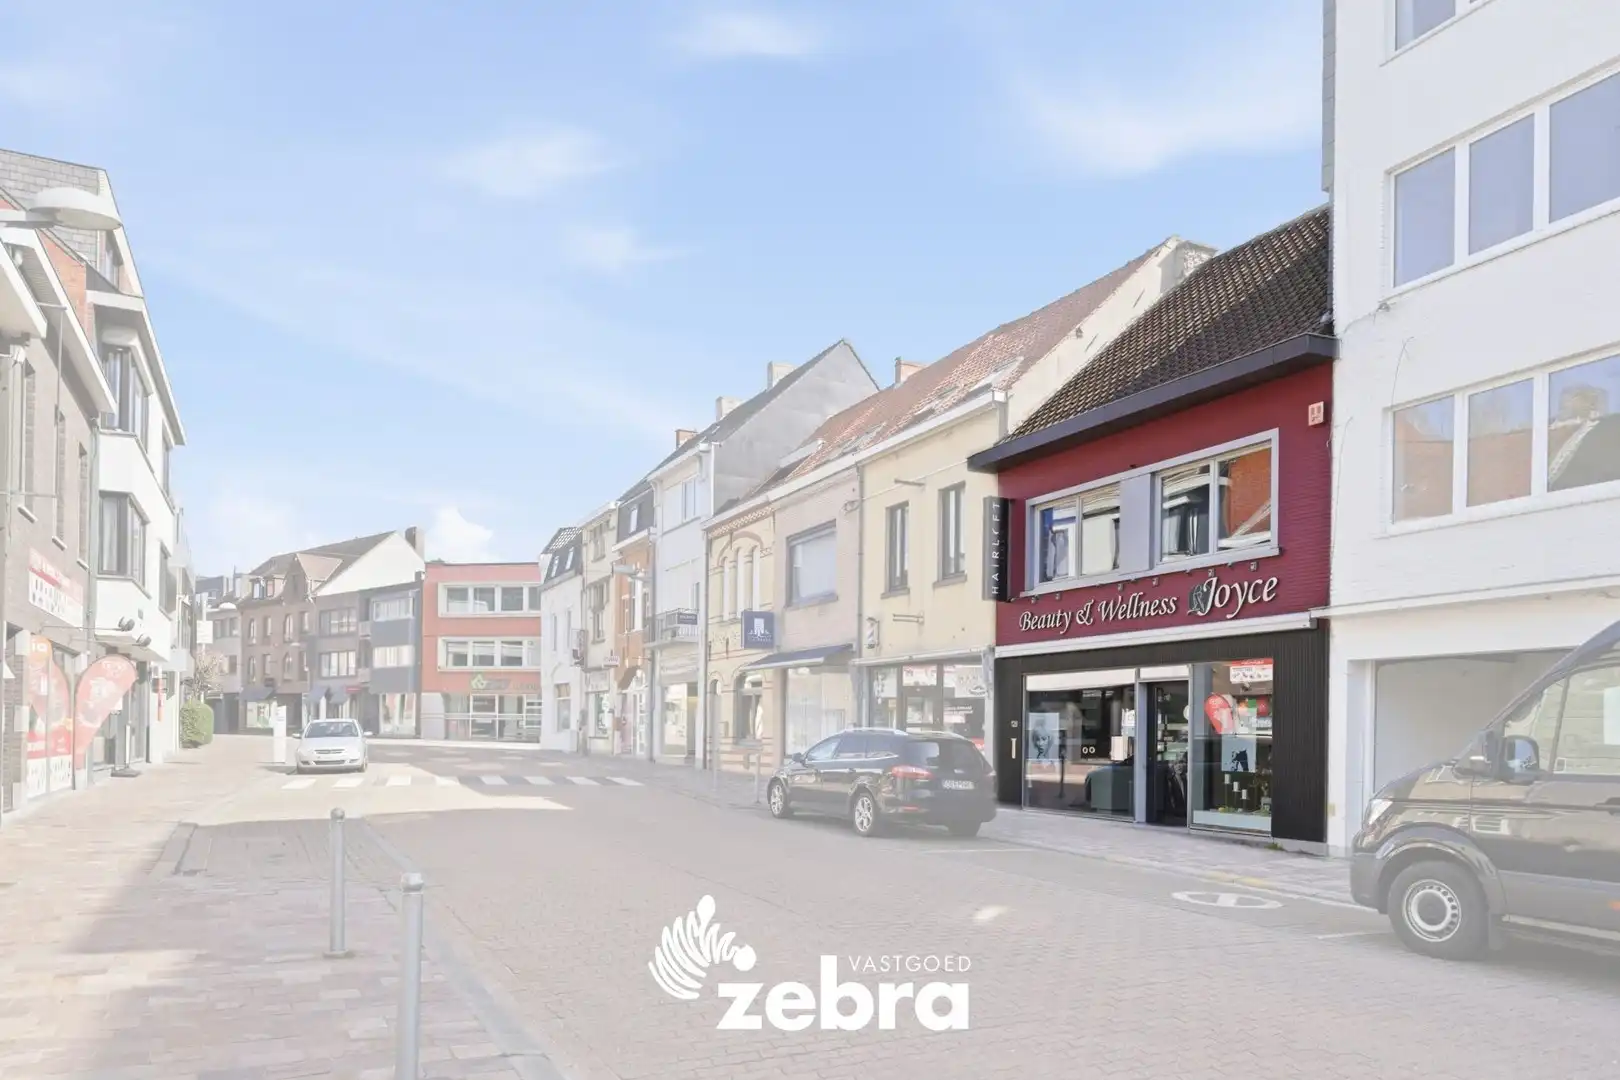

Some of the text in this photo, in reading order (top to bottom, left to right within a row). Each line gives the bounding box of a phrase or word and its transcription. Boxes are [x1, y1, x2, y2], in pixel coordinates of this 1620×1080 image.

[1018, 576, 1278, 635] Beauty & Wellness Joyce
